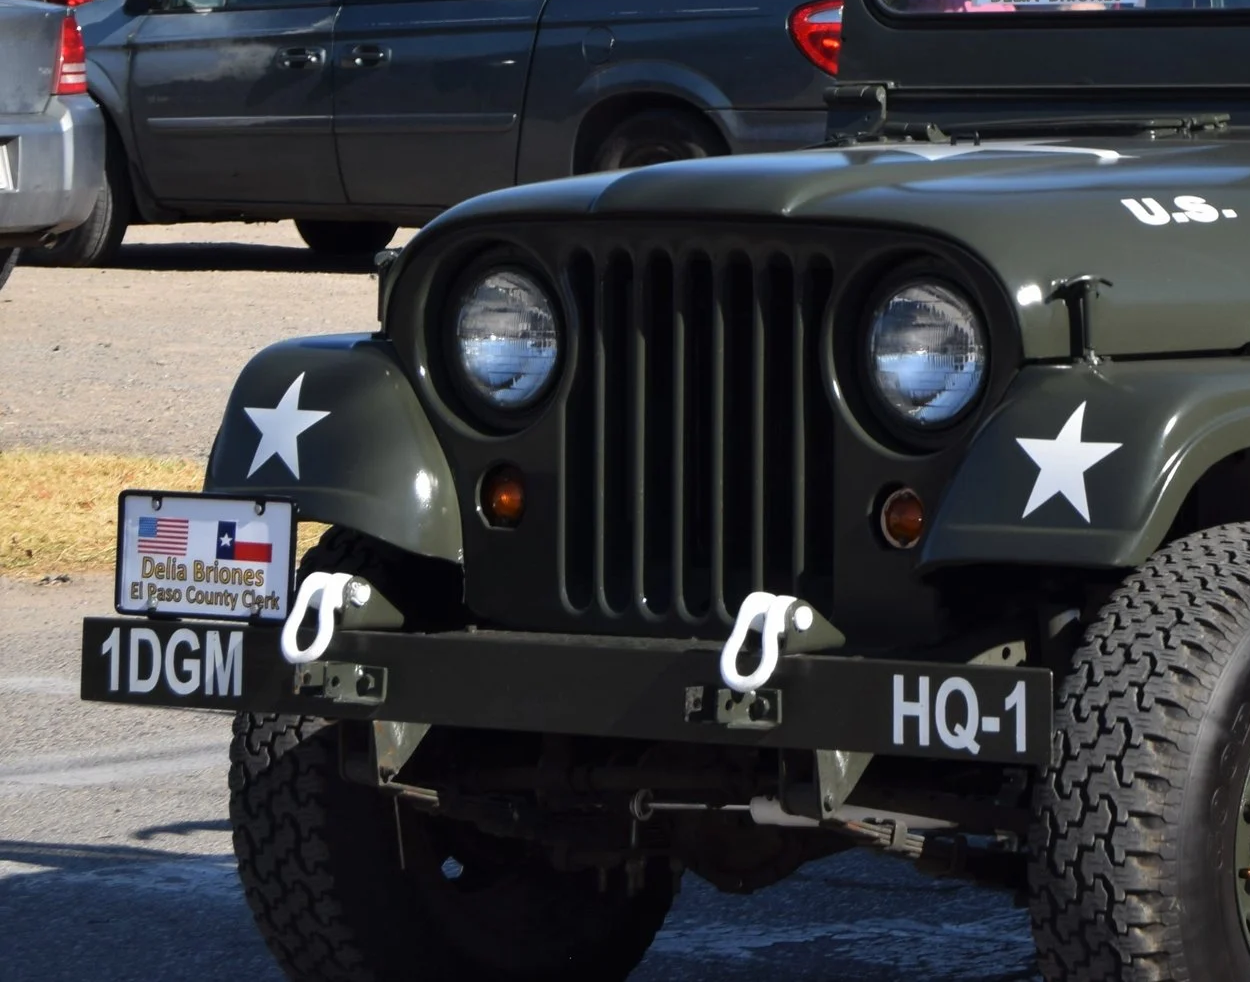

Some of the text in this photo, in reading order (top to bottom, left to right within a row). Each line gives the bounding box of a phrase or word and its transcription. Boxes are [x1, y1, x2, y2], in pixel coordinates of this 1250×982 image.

[1120, 195, 1237, 226] U.S.
[141, 556, 265, 587] Delia Briones
[130, 581, 281, 611] El Paso County Clerk
[101, 626, 244, 697] 1DGM
[893, 674, 1027, 755] HQ-1
